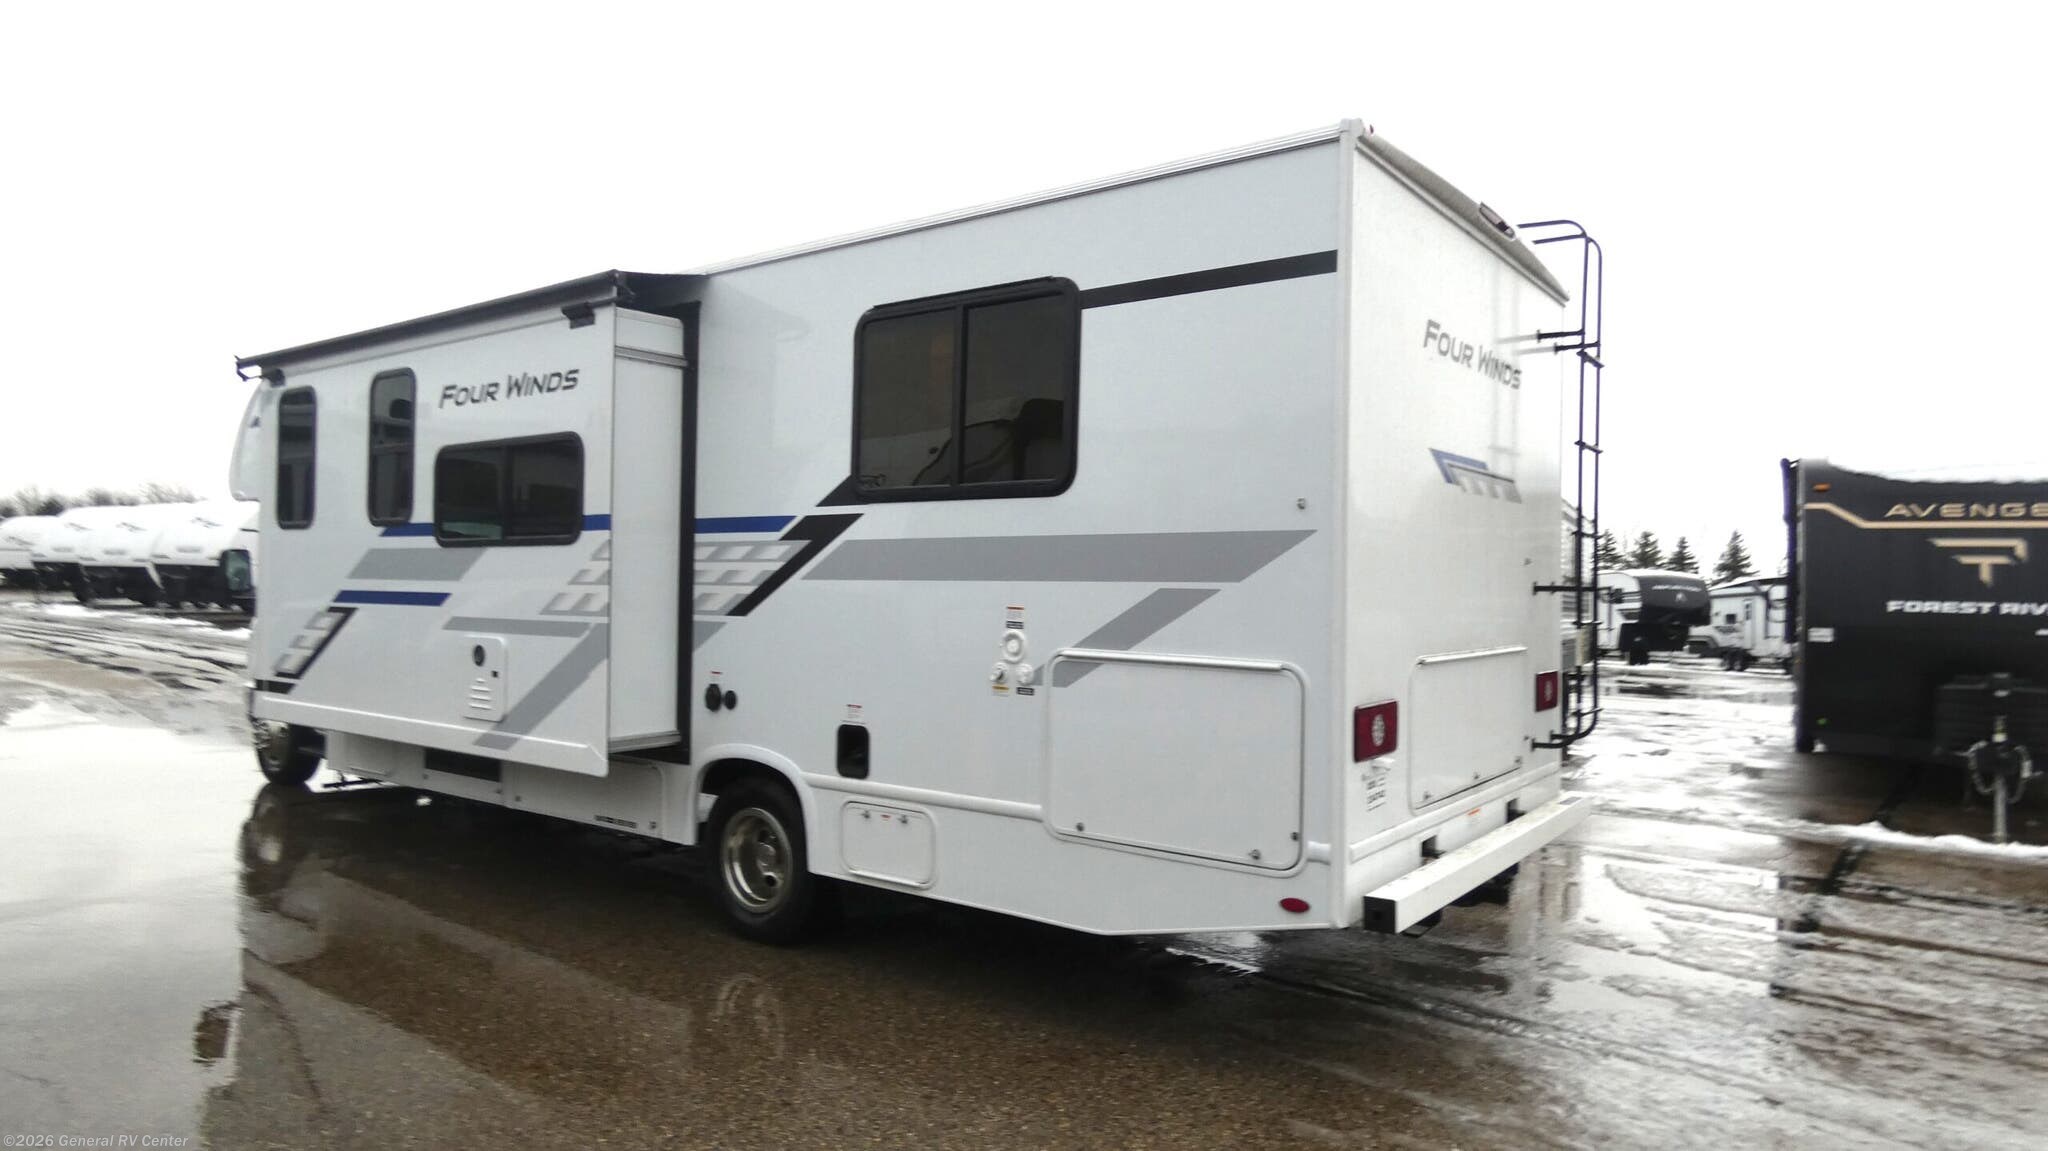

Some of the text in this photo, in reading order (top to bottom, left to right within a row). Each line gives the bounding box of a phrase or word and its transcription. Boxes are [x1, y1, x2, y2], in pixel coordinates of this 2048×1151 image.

[1423, 319, 1522, 390] FOUR WINDS
[438, 369, 580, 409] FOUR WINDS
[1884, 502, 2048, 518] AVENGE
[1886, 600, 1996, 614] FOREST
